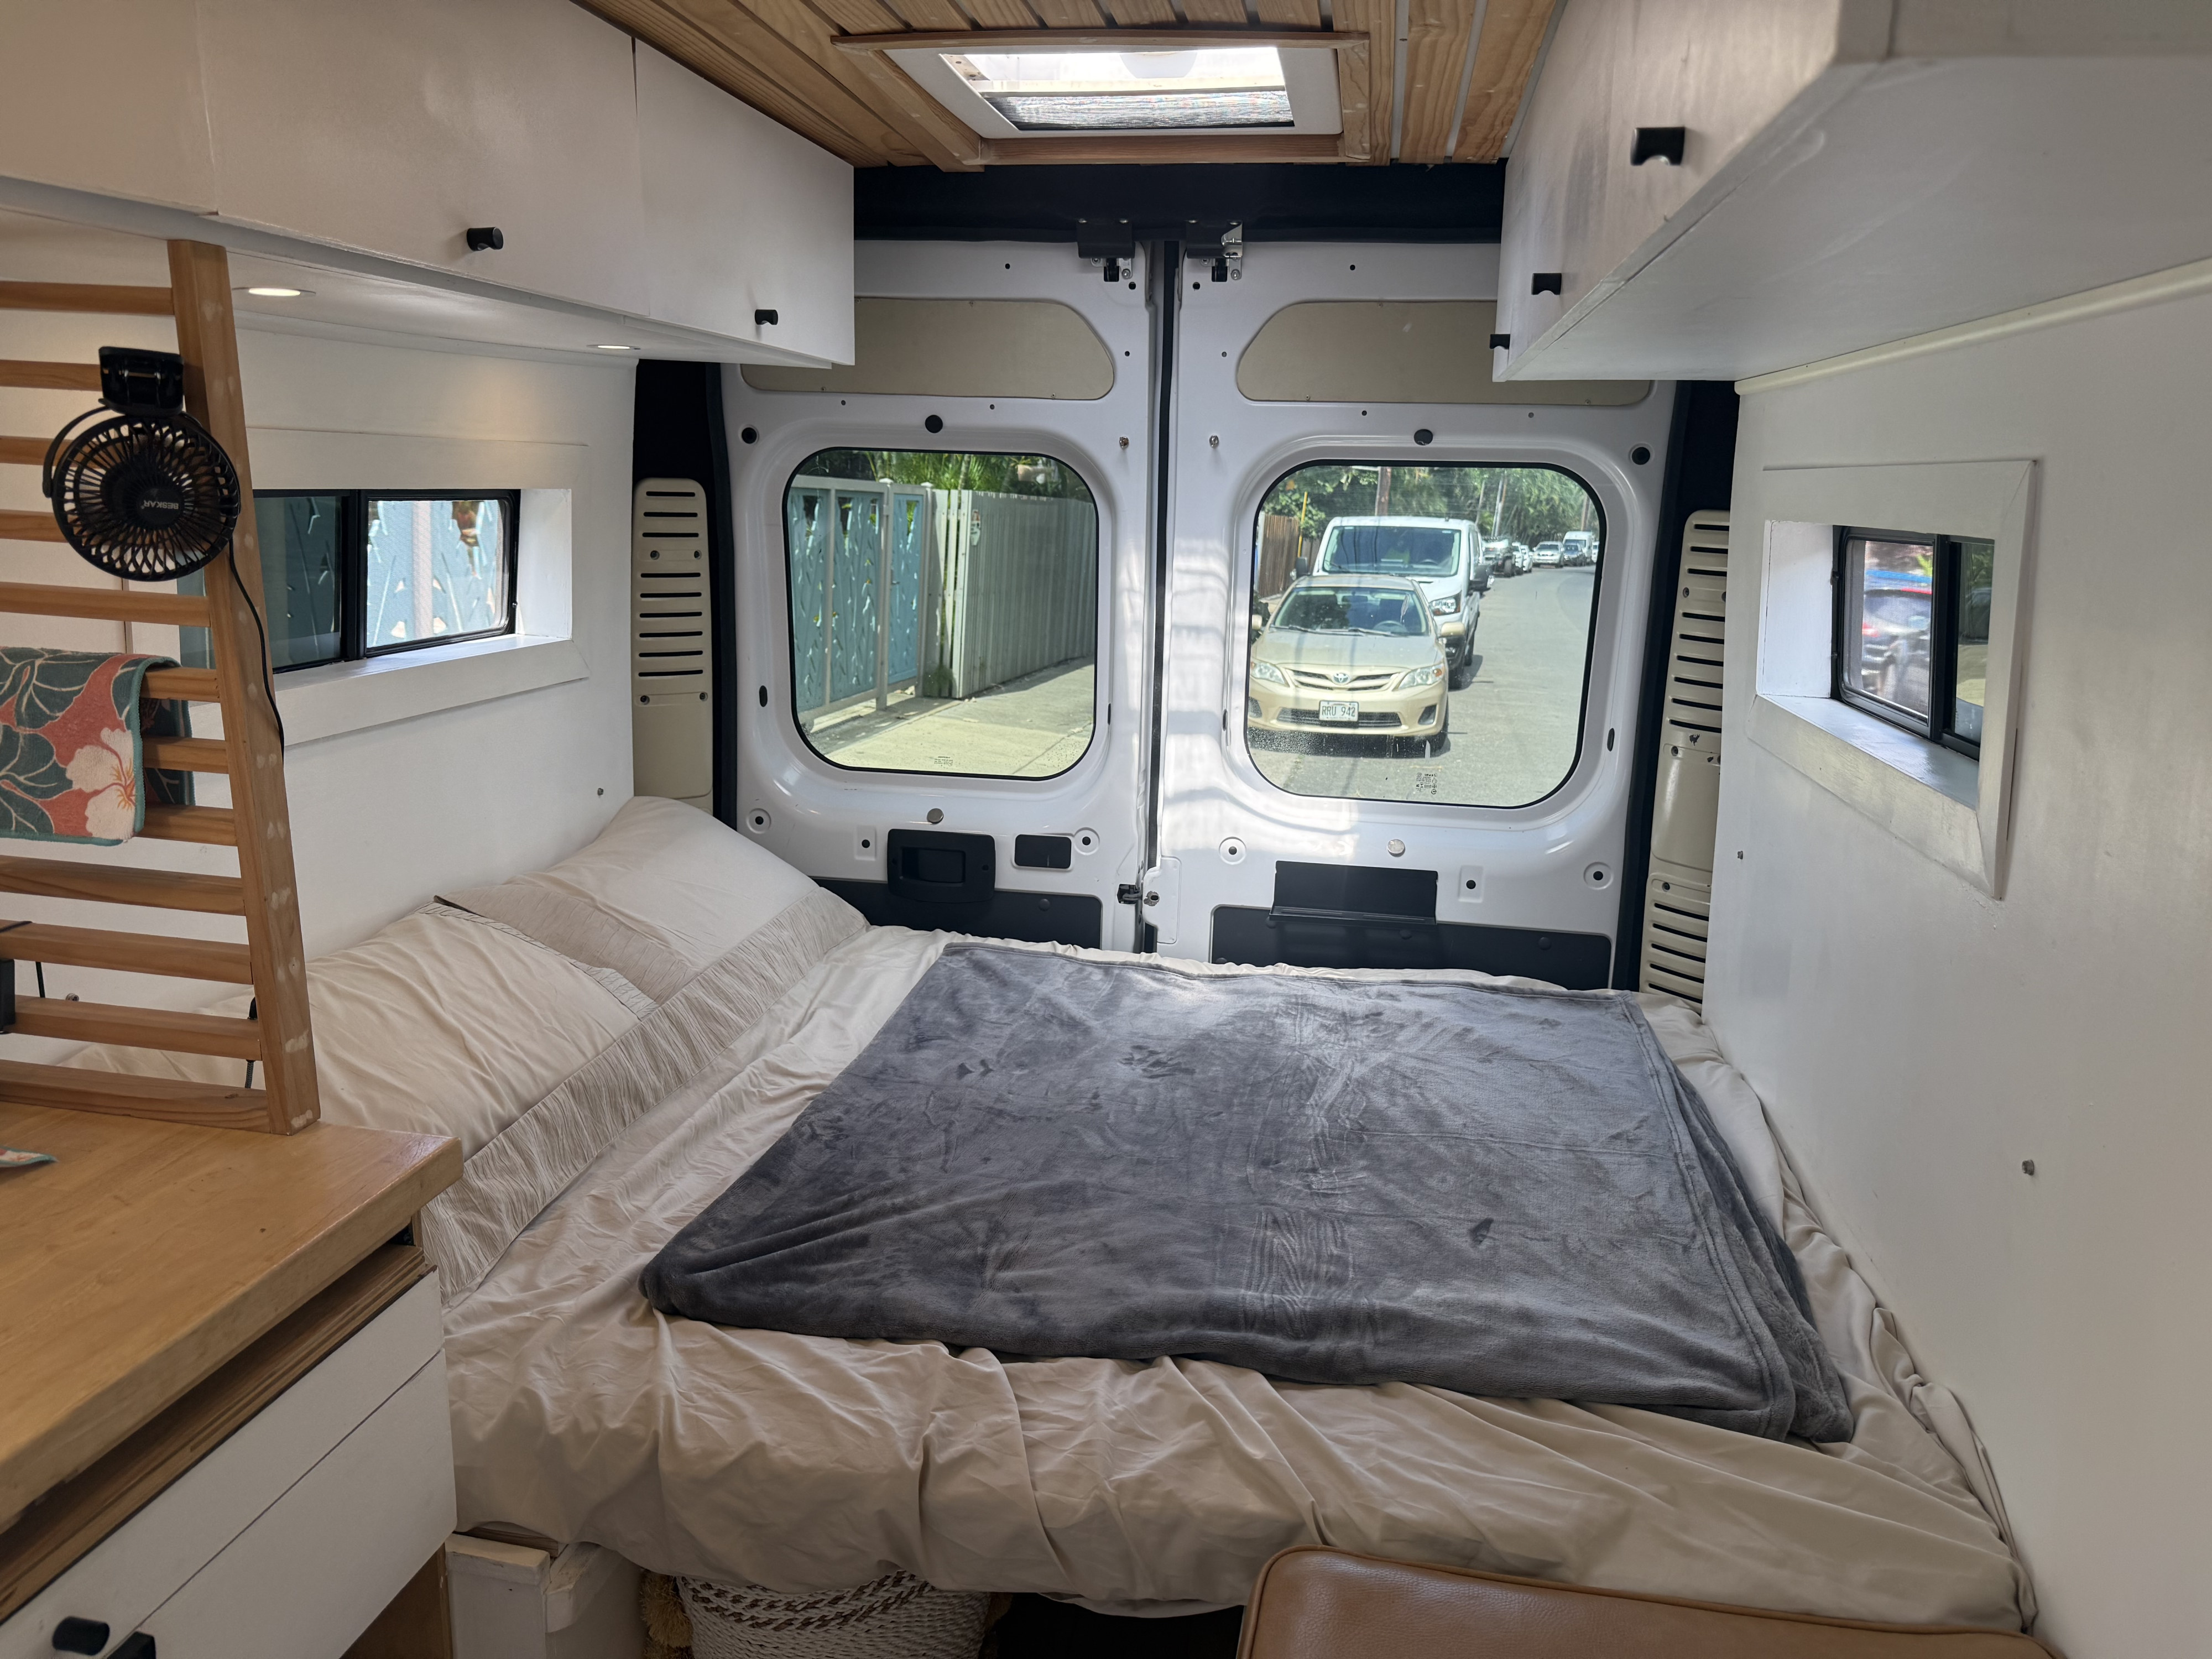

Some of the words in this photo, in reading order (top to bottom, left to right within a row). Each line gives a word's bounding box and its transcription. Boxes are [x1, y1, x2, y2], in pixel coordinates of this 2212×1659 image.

[144, 500, 179, 509] BESKAR
[1322, 706, 1336, 716] RRU
[1341, 707, 1355, 717] 942
